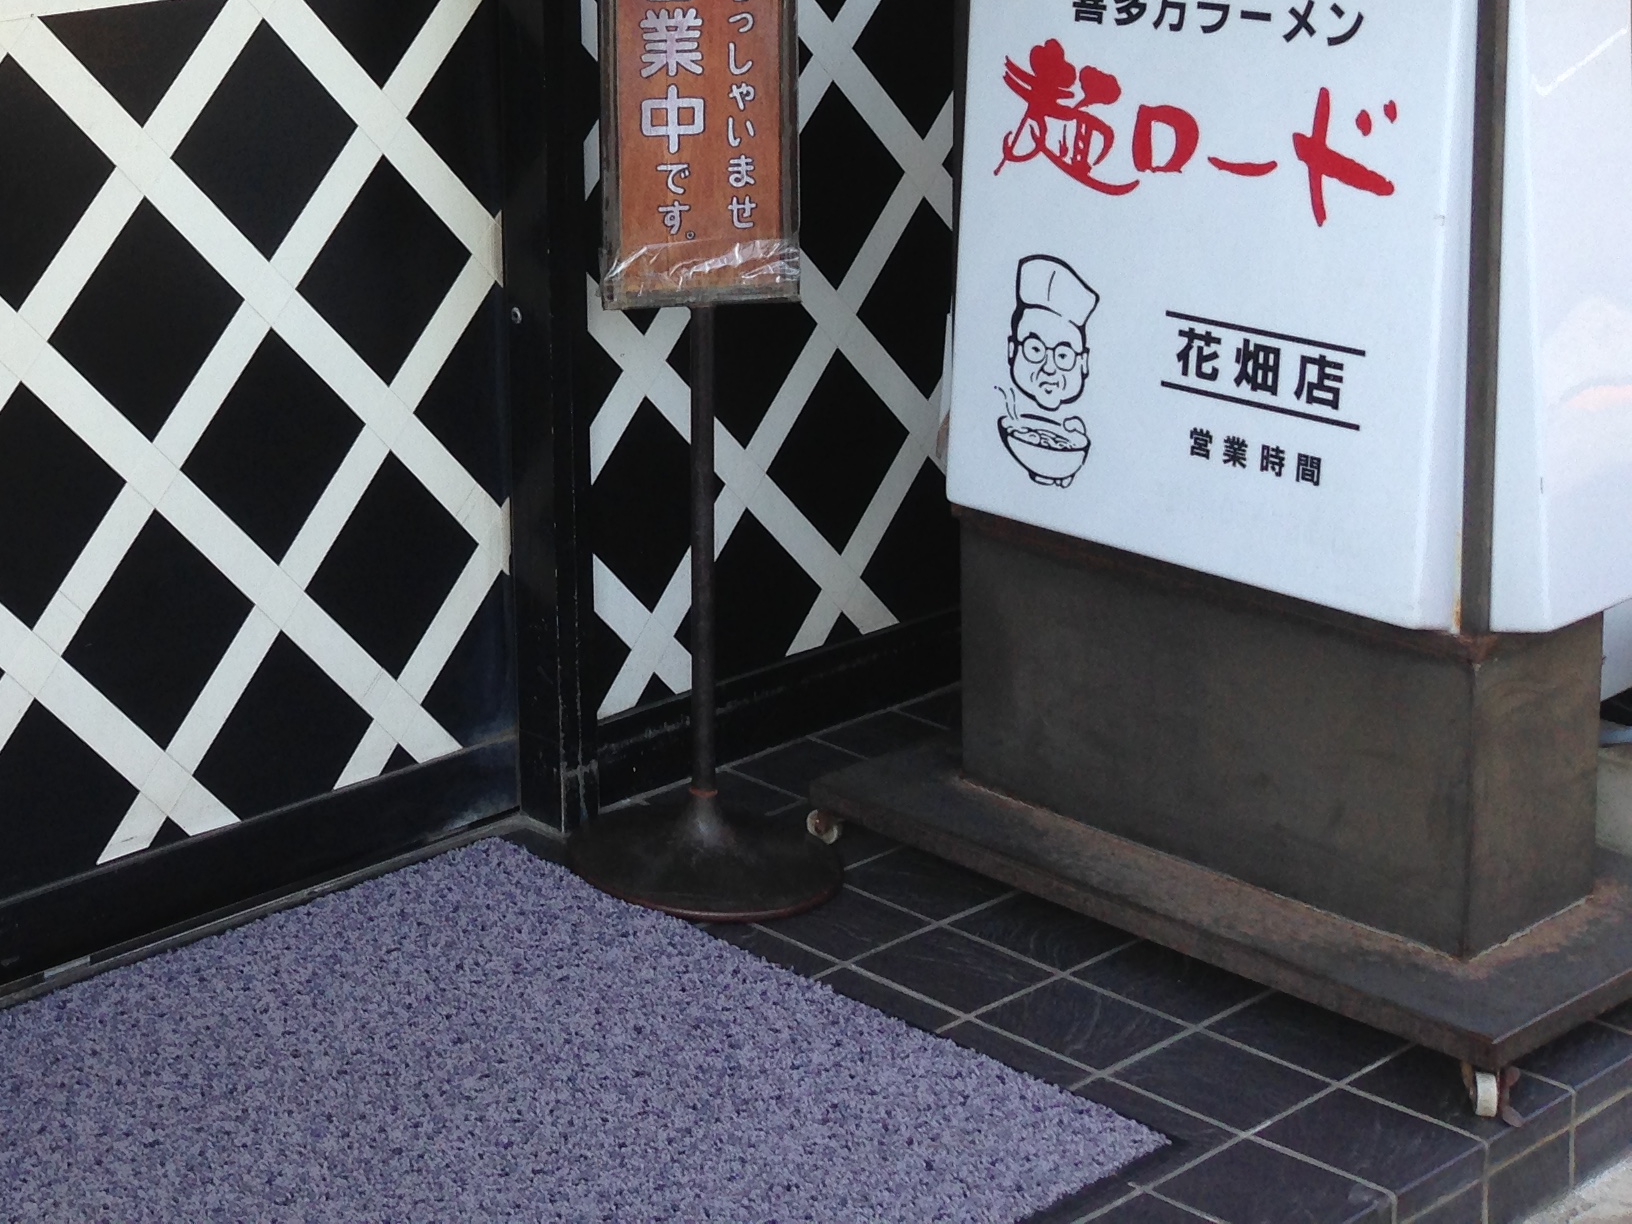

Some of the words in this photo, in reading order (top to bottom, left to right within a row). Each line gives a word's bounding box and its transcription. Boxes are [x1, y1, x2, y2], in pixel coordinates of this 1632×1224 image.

[994, 38, 1398, 227] 麺ロード
[1175, 327, 1345, 411] 花畑店
[1188, 426, 1323, 487] 営業時間
